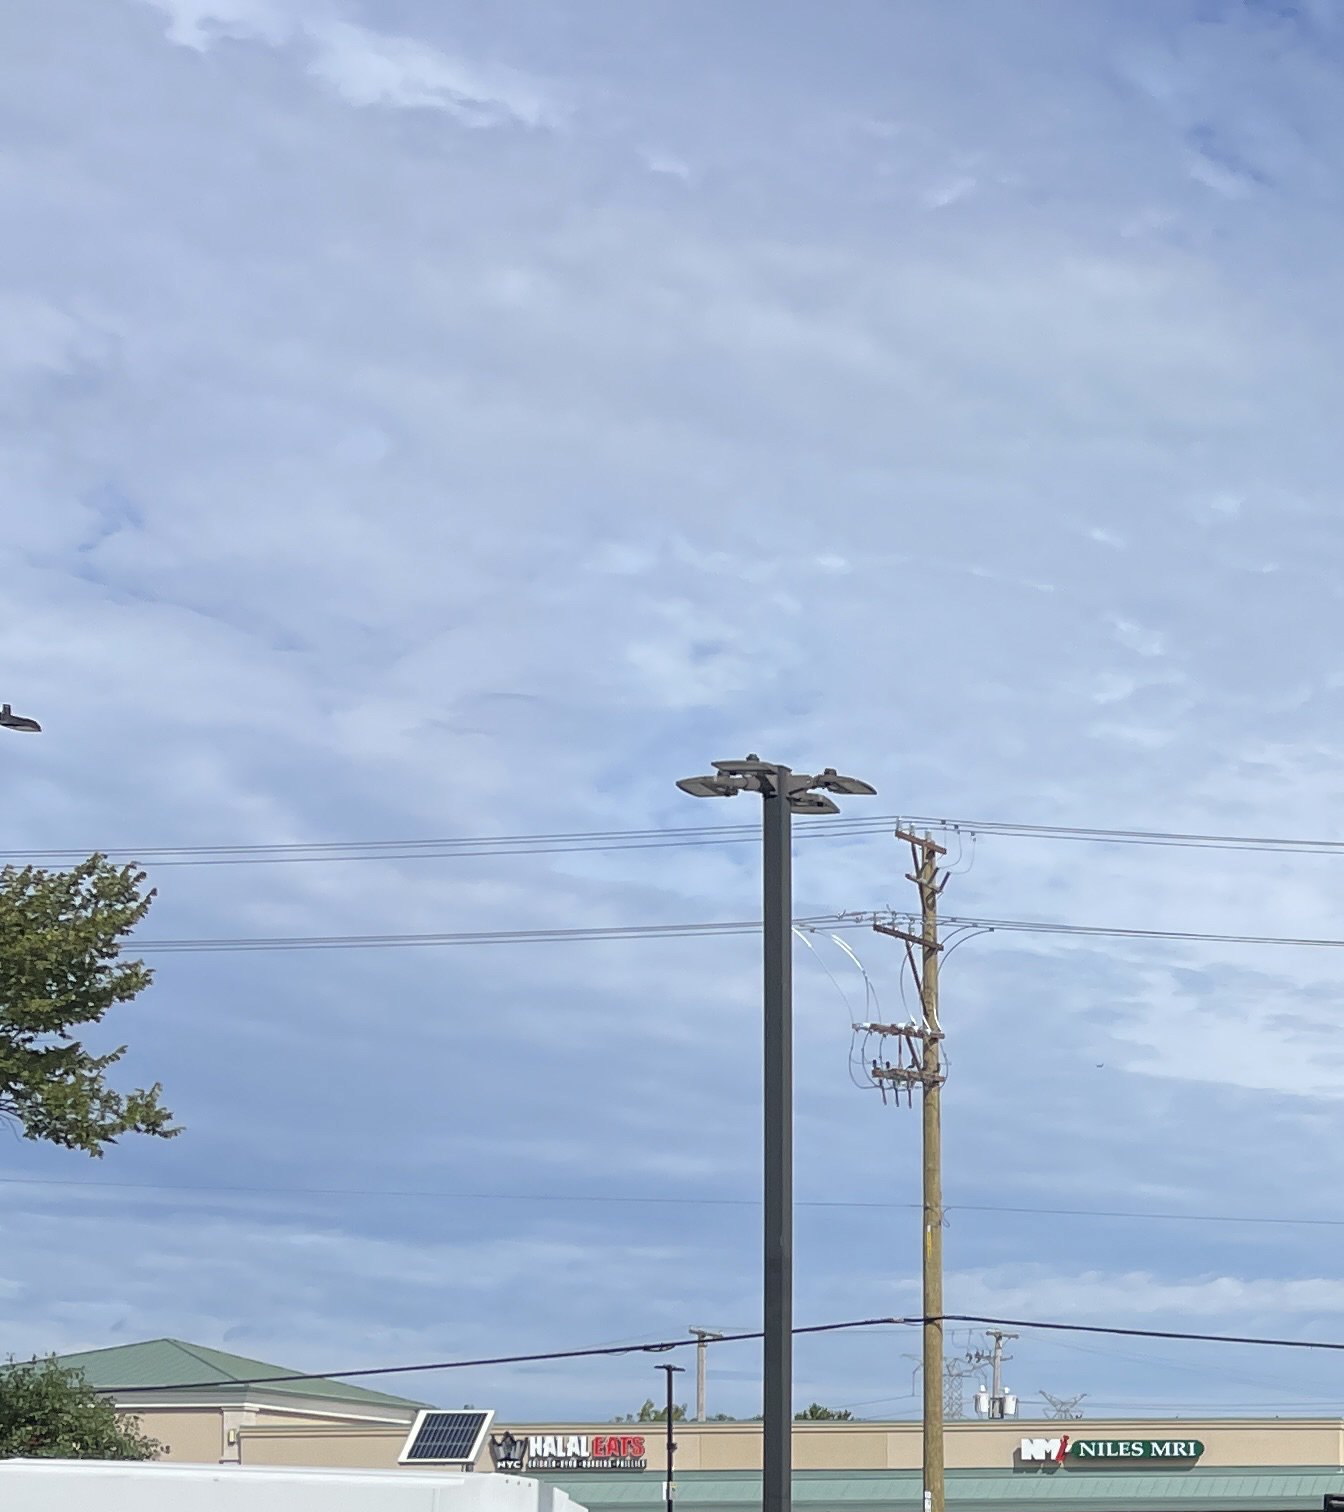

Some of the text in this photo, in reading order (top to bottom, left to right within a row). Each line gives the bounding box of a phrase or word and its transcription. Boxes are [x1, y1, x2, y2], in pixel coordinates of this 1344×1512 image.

[529, 1434, 646, 1457] HALAL EATS
[1079, 1441, 1196, 1457] NILES MRI
[497, 1460, 521, 1469] NYC
